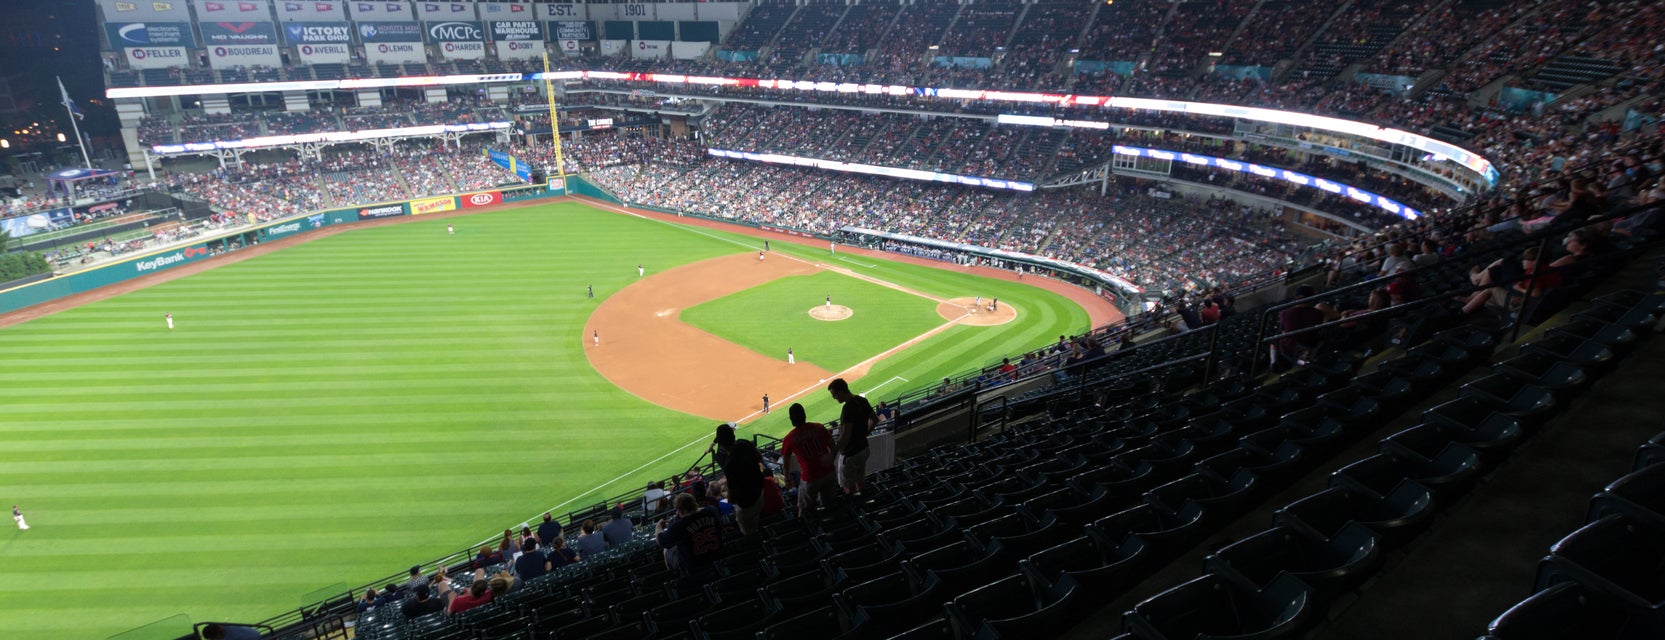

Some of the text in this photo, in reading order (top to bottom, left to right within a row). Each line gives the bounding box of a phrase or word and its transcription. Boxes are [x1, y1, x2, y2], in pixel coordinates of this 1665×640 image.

[547, 4, 646, 16] EST. 1901
[228, 47, 273, 56] BOUDREAU
[314, 46, 346, 54] AVERILL
[388, 44, 413, 52] LEMON
[455, 43, 482, 51] HARDER
[146, 49, 182, 58] FELLER
[473, 195, 491, 204] KIA
[136, 252, 185, 272] KeyBank
